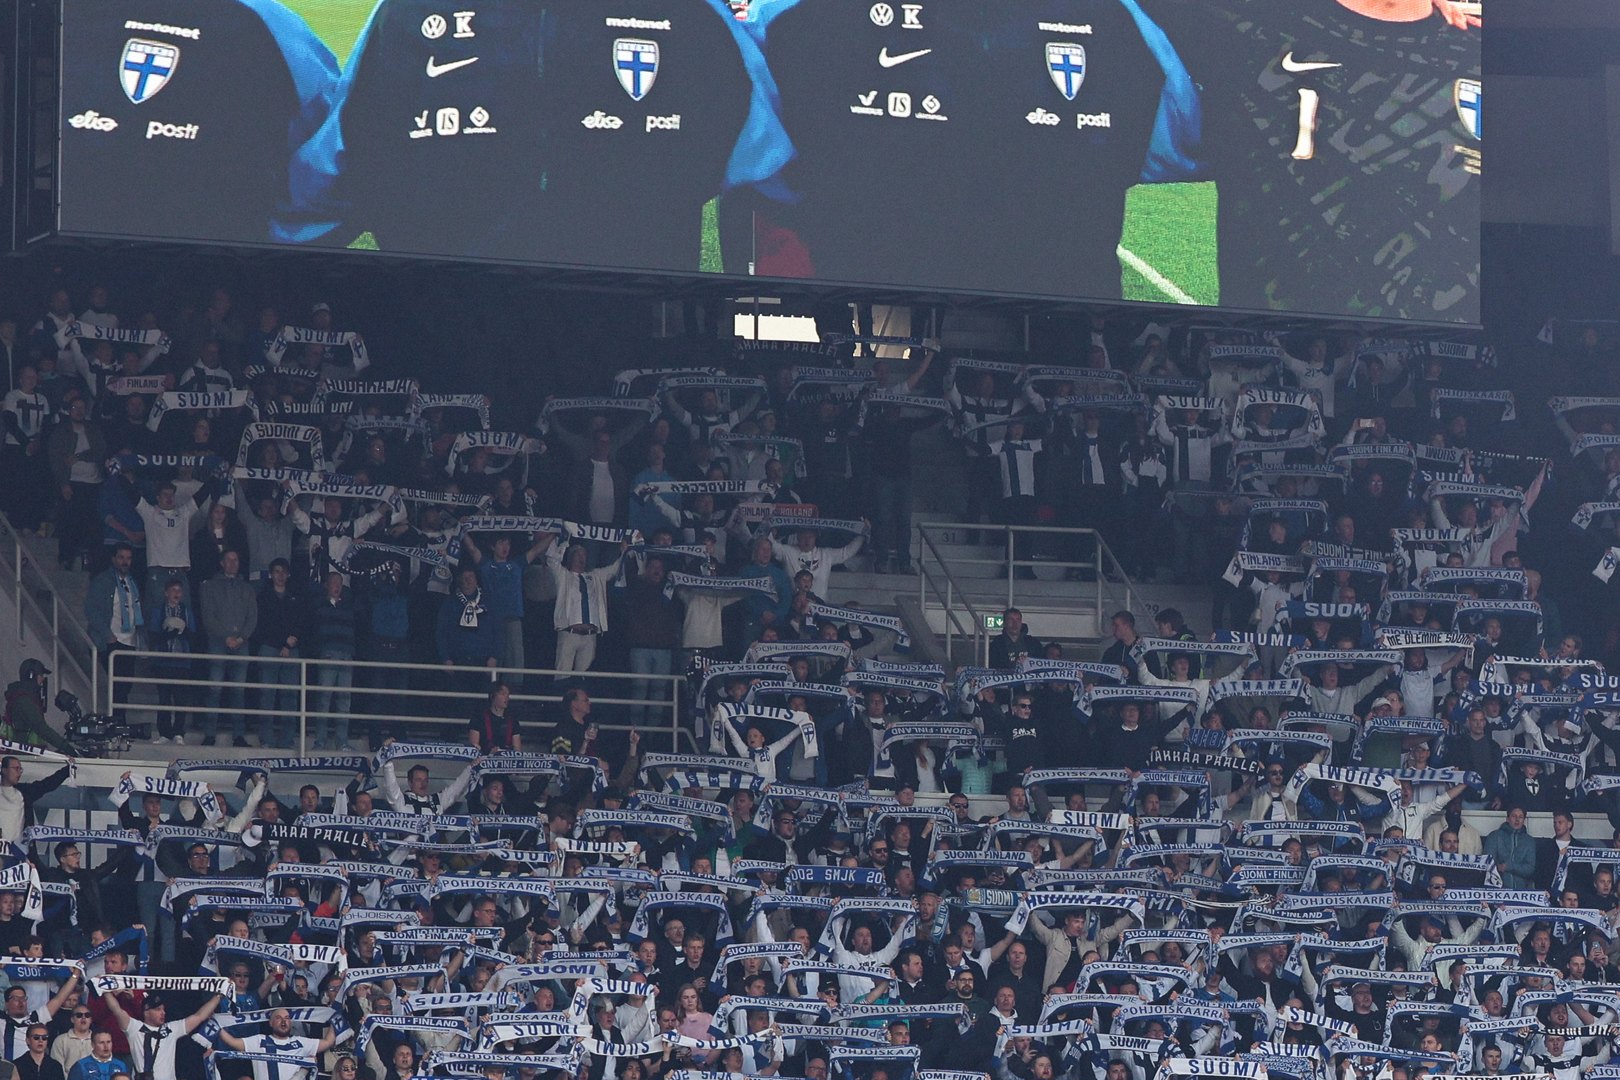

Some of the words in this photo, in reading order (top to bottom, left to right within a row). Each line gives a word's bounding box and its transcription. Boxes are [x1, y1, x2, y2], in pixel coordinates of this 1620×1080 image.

[125, 20, 200, 40] motonet
[605, 17, 671, 30] motonet
[1038, 22, 1093, 34] motonet
[69, 110, 118, 131] elisa
[581, 111, 623, 129] elisa
[645, 115, 681, 132] posti
[1025, 107, 1060, 126] elisa
[1076, 113, 1111, 129] posti
[1291, 88, 1319, 159] 1
[146, 121, 199, 139] posti
[95, 326, 149, 343] SUOMI
[293, 327, 351, 344] SUOMI
[177, 392, 233, 407] SUOMI
[1400, 529, 1459, 541] SUOMI
[324, 757, 362, 768] 2003
[145, 778, 200, 796] SUOMI
[943, 851, 979, 860] SUOMI
[986, 851, 1026, 861] FINLAND
[442, 878, 550, 893] POHJOISKAARRE
[207, 896, 244, 906] SUOMI
[254, 897, 293, 907] FINLAND
[414, 993, 493, 1008] SUOMI
[852, 1004, 963, 1017] POHJOISKAARRE
[1109, 1036, 1149, 1050] SUOMI
[1190, 1060, 1259, 1078] SUOMI
